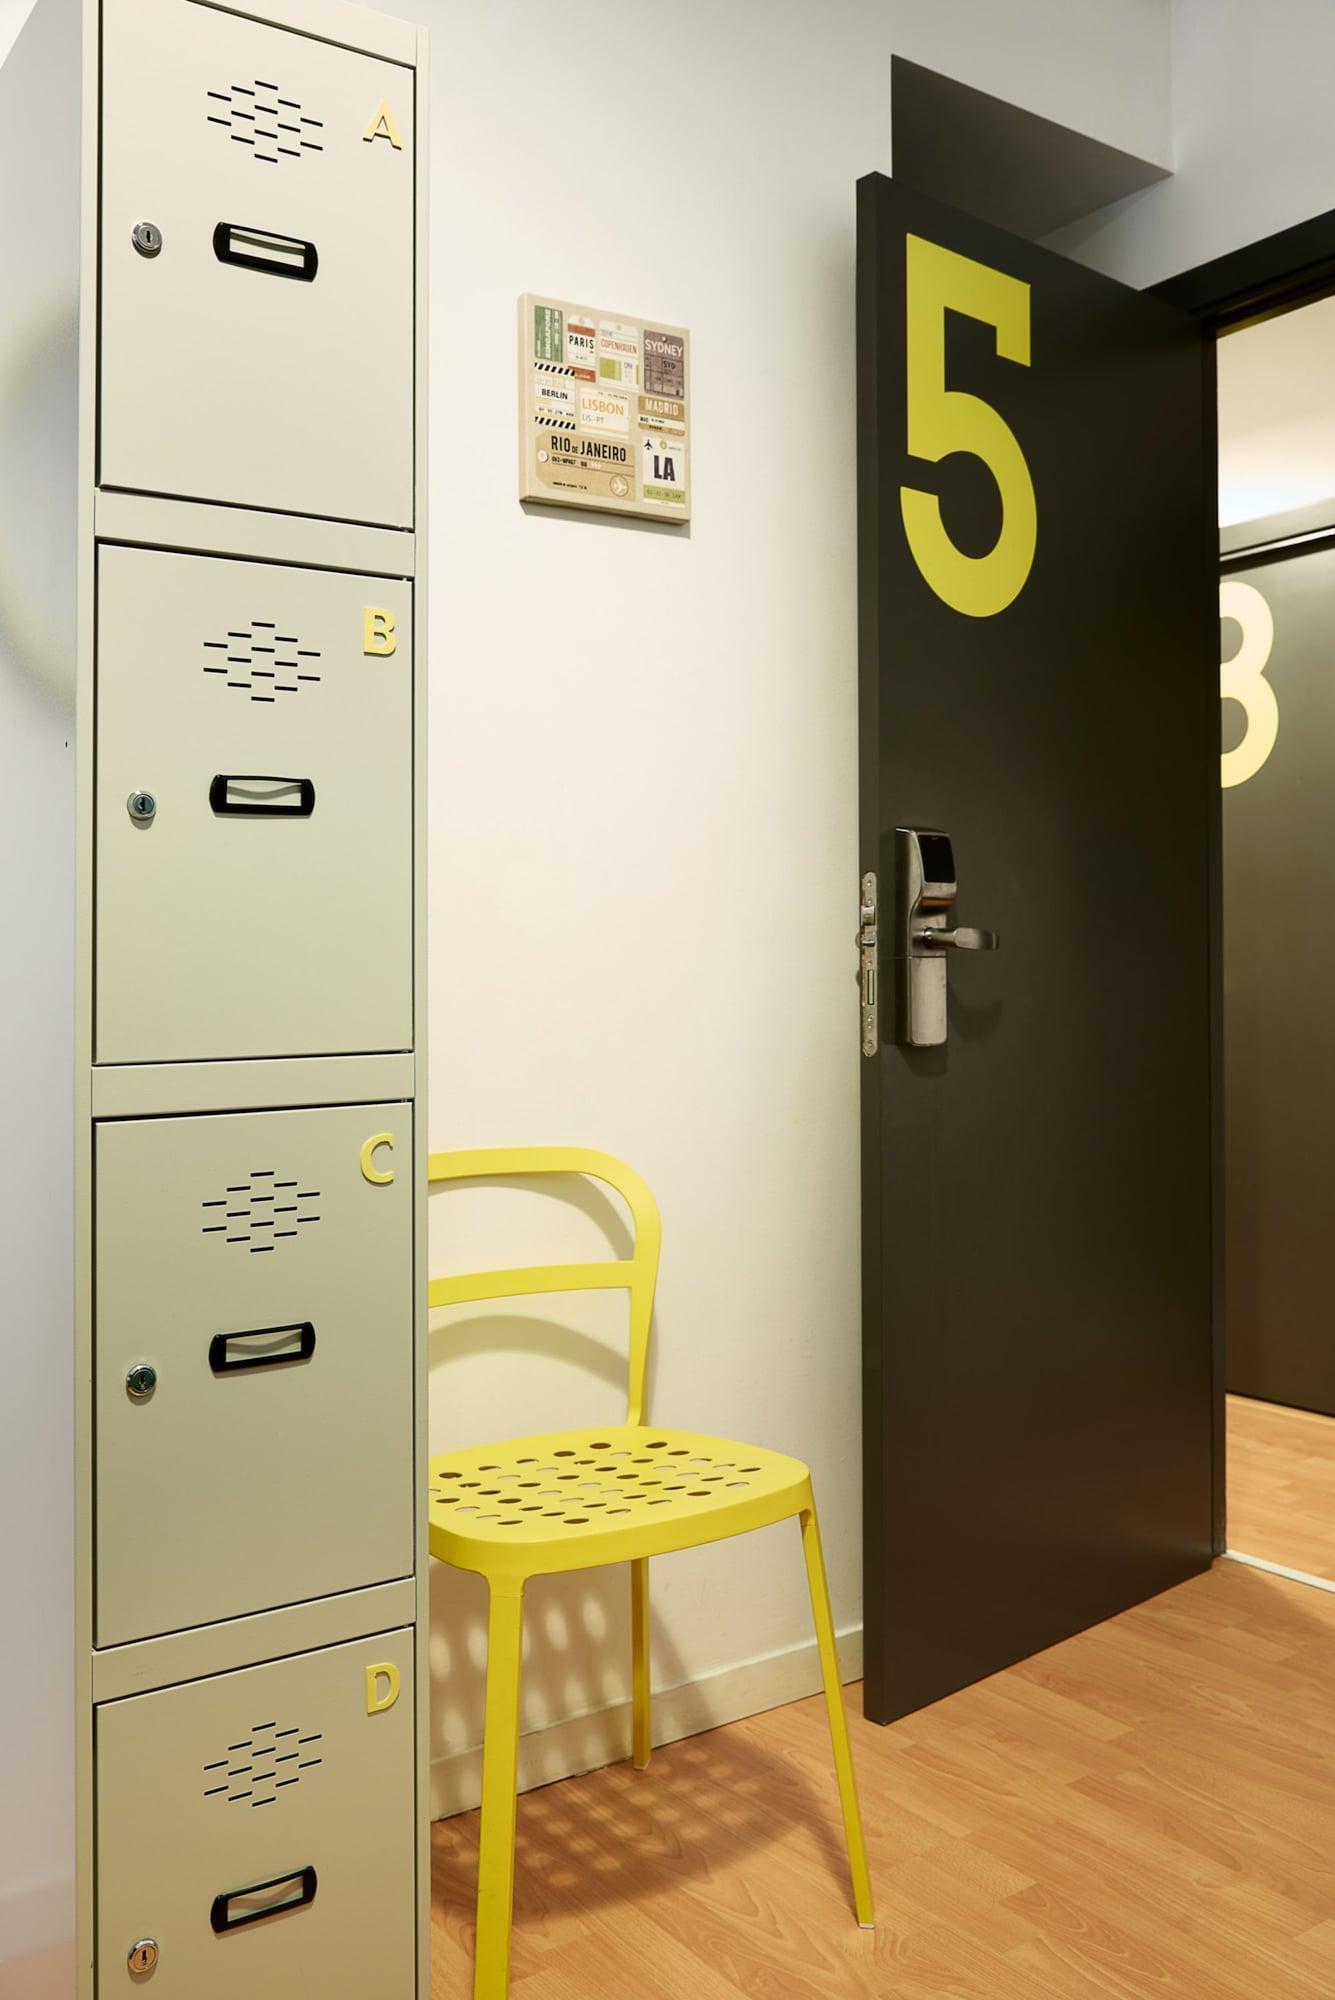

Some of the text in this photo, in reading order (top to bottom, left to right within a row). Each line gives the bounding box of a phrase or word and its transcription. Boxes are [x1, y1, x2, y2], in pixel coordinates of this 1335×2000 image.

[363, 97, 402, 150] A
[568, 335, 595, 350] PARIS
[600, 338, 637, 354] COPENHAGEN
[645, 338, 684, 357] SYDNEY
[541, 388, 568, 400] BERLIN
[581, 398, 624, 416] LISBON
[645, 398, 679, 416] MADRID
[900, 233, 1037, 618] 5
[551, 435, 627, 462] RIO DE JANEIRO
[653, 454, 676, 481] LA
[363, 606, 397, 658] B
[360, 1132, 396, 1187] C
[365, 1662, 401, 1718] D
